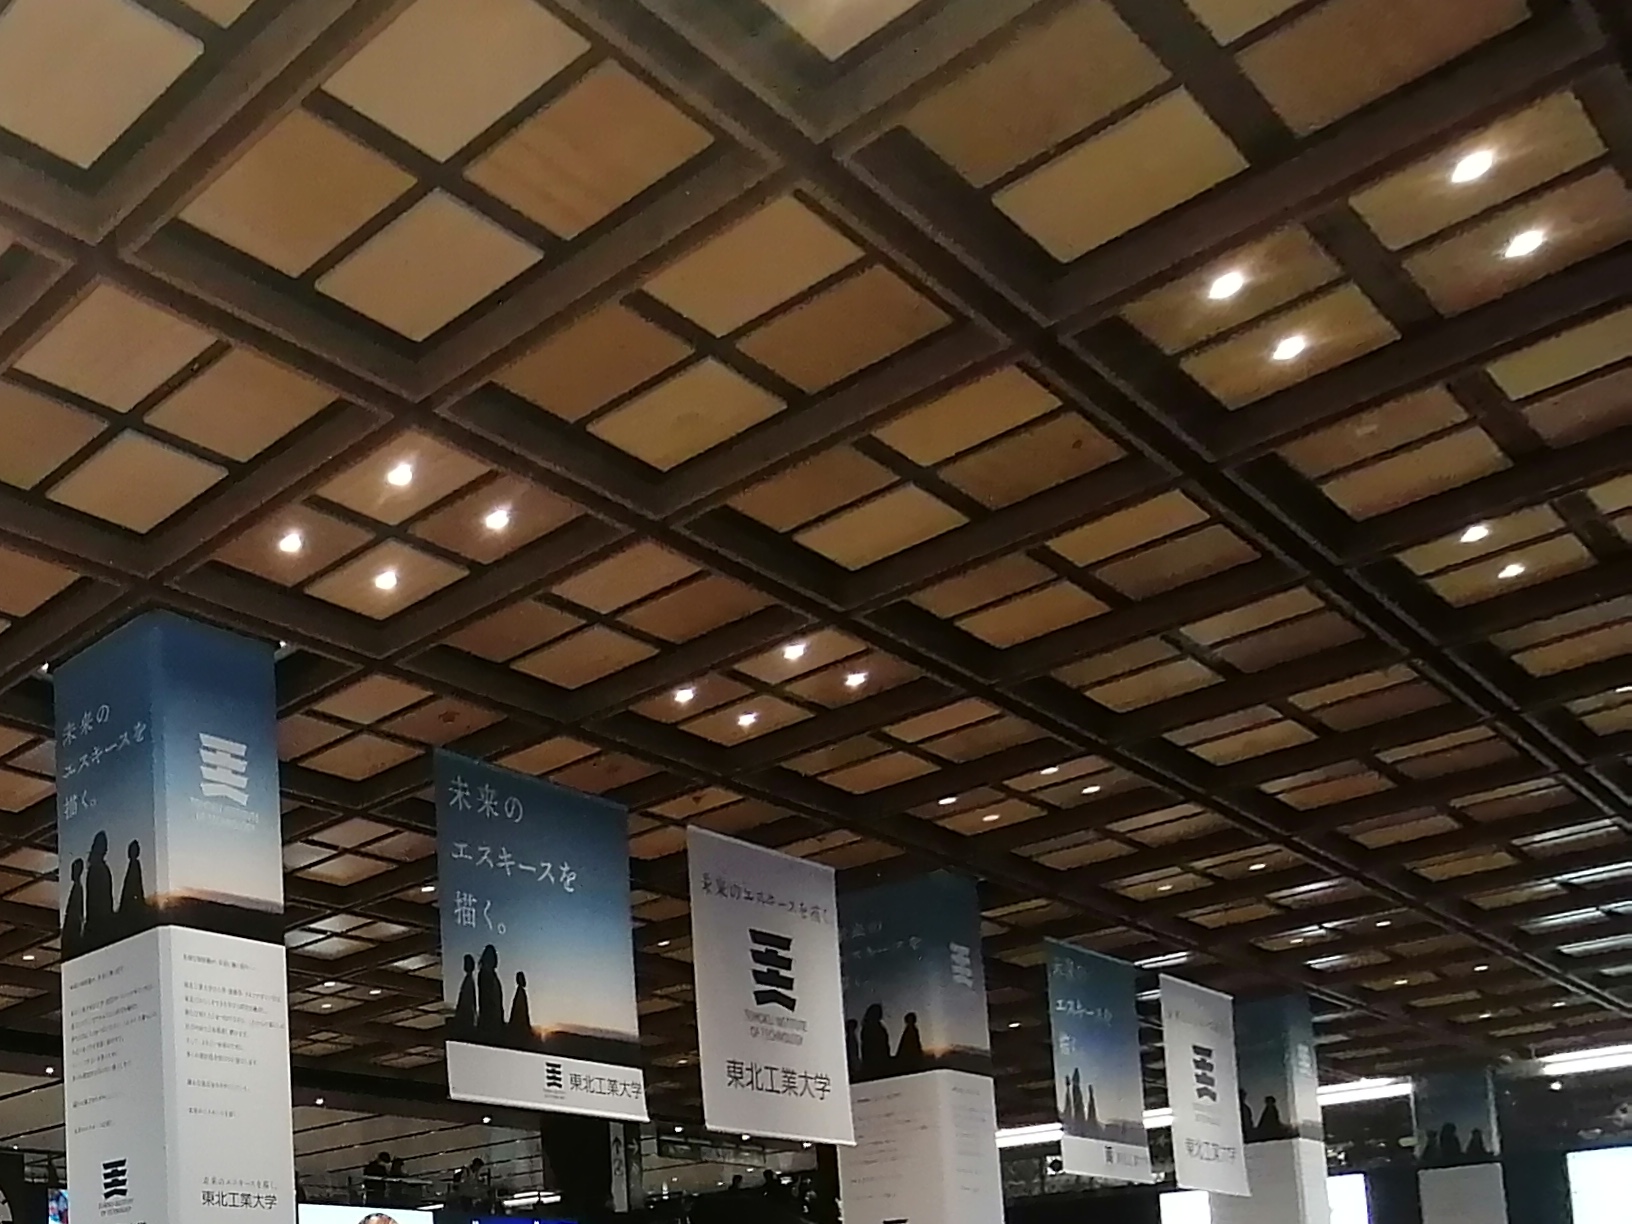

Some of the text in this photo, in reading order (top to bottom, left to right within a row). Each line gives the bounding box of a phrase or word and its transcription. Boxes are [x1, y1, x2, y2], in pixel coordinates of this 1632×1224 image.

[62, 704, 110, 748] 未来の
[447, 775, 524, 824] 未来の
[451, 841, 578, 894] エスキースを
[454, 890, 508, 936] 描く。
[569, 1073, 643, 1100] 東北工業大学
[726, 1059, 831, 1101] 東北工業大学
[202, 1191, 278, 1210] 東北工業大学
